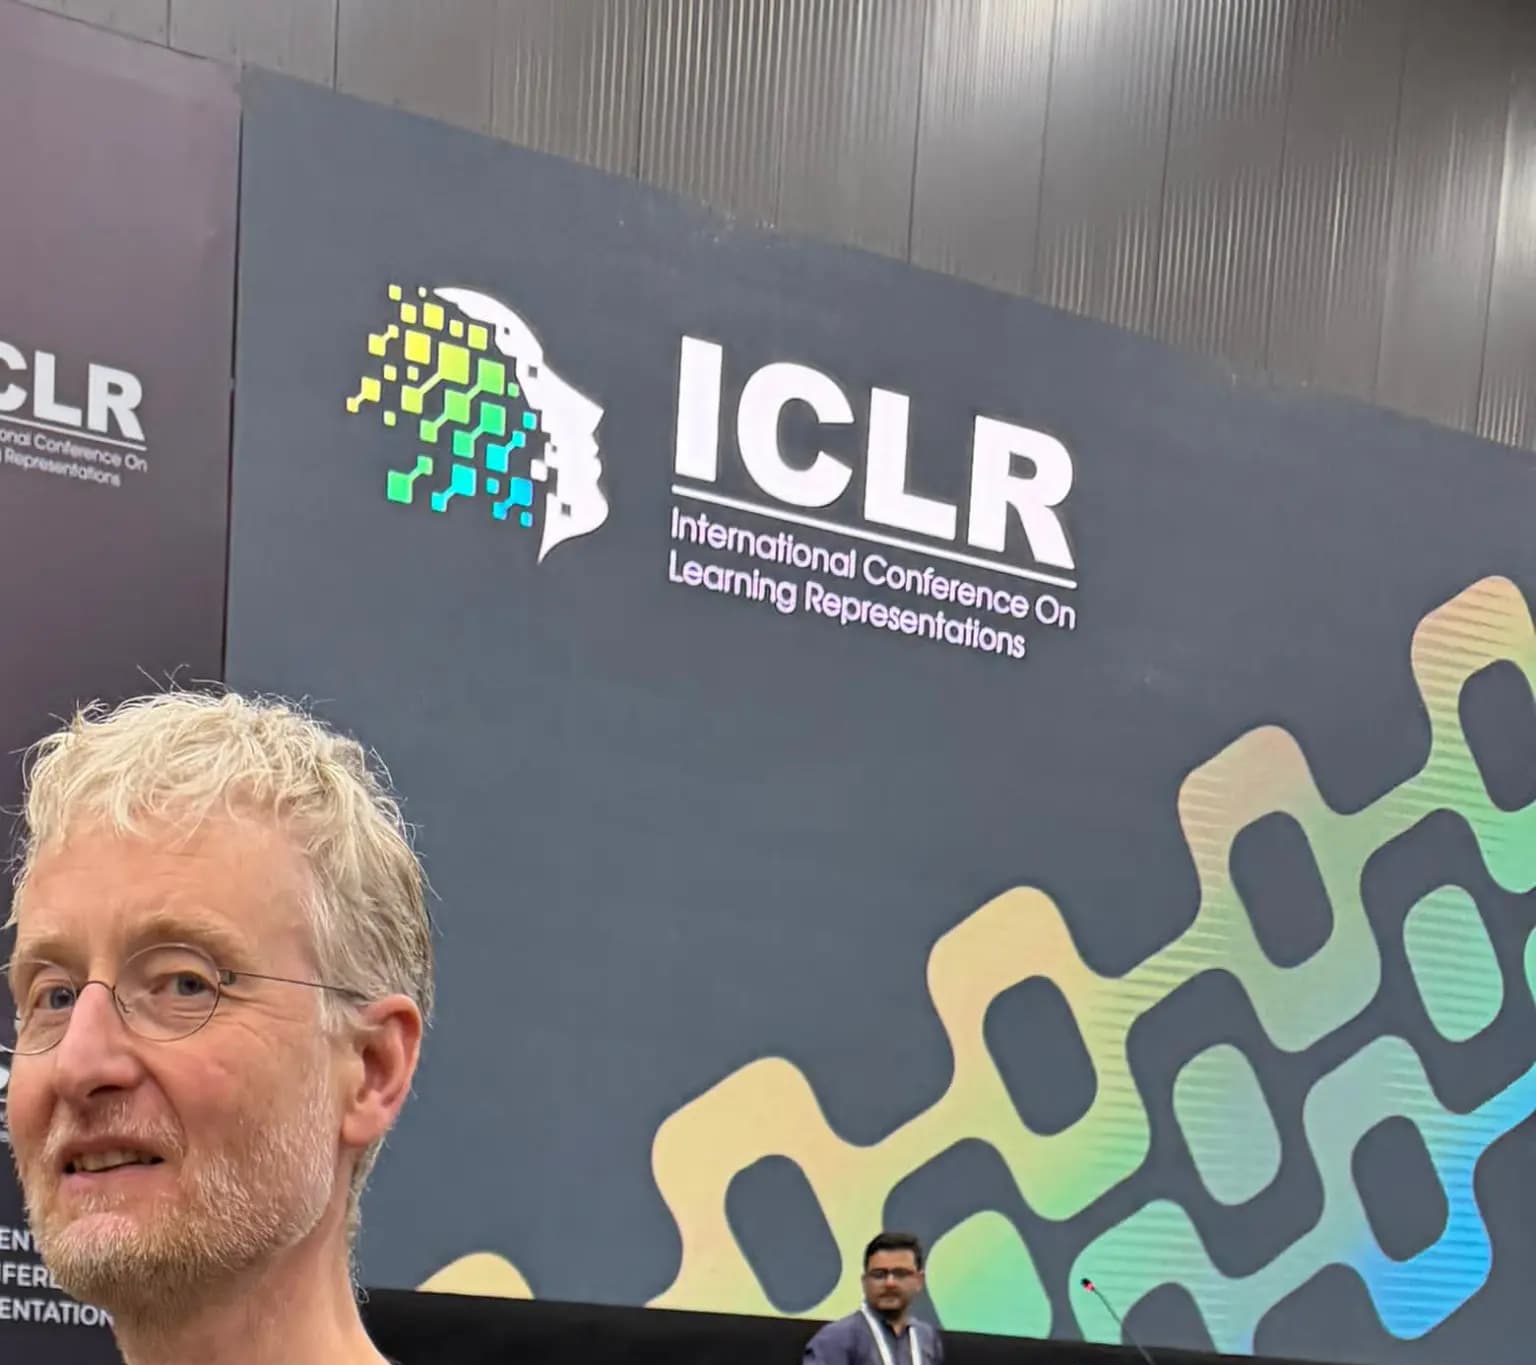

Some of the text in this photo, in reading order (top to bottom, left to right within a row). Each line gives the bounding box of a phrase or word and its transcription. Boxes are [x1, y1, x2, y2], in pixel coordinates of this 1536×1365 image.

[4, 446, 121, 487] Representations
[33, 433, 122, 468] Conference
[124, 453, 148, 472] On
[675, 335, 1075, 570] ICLR
[669, 549, 1026, 659] Learning Representations
[671, 506, 1076, 631] International Conference On
